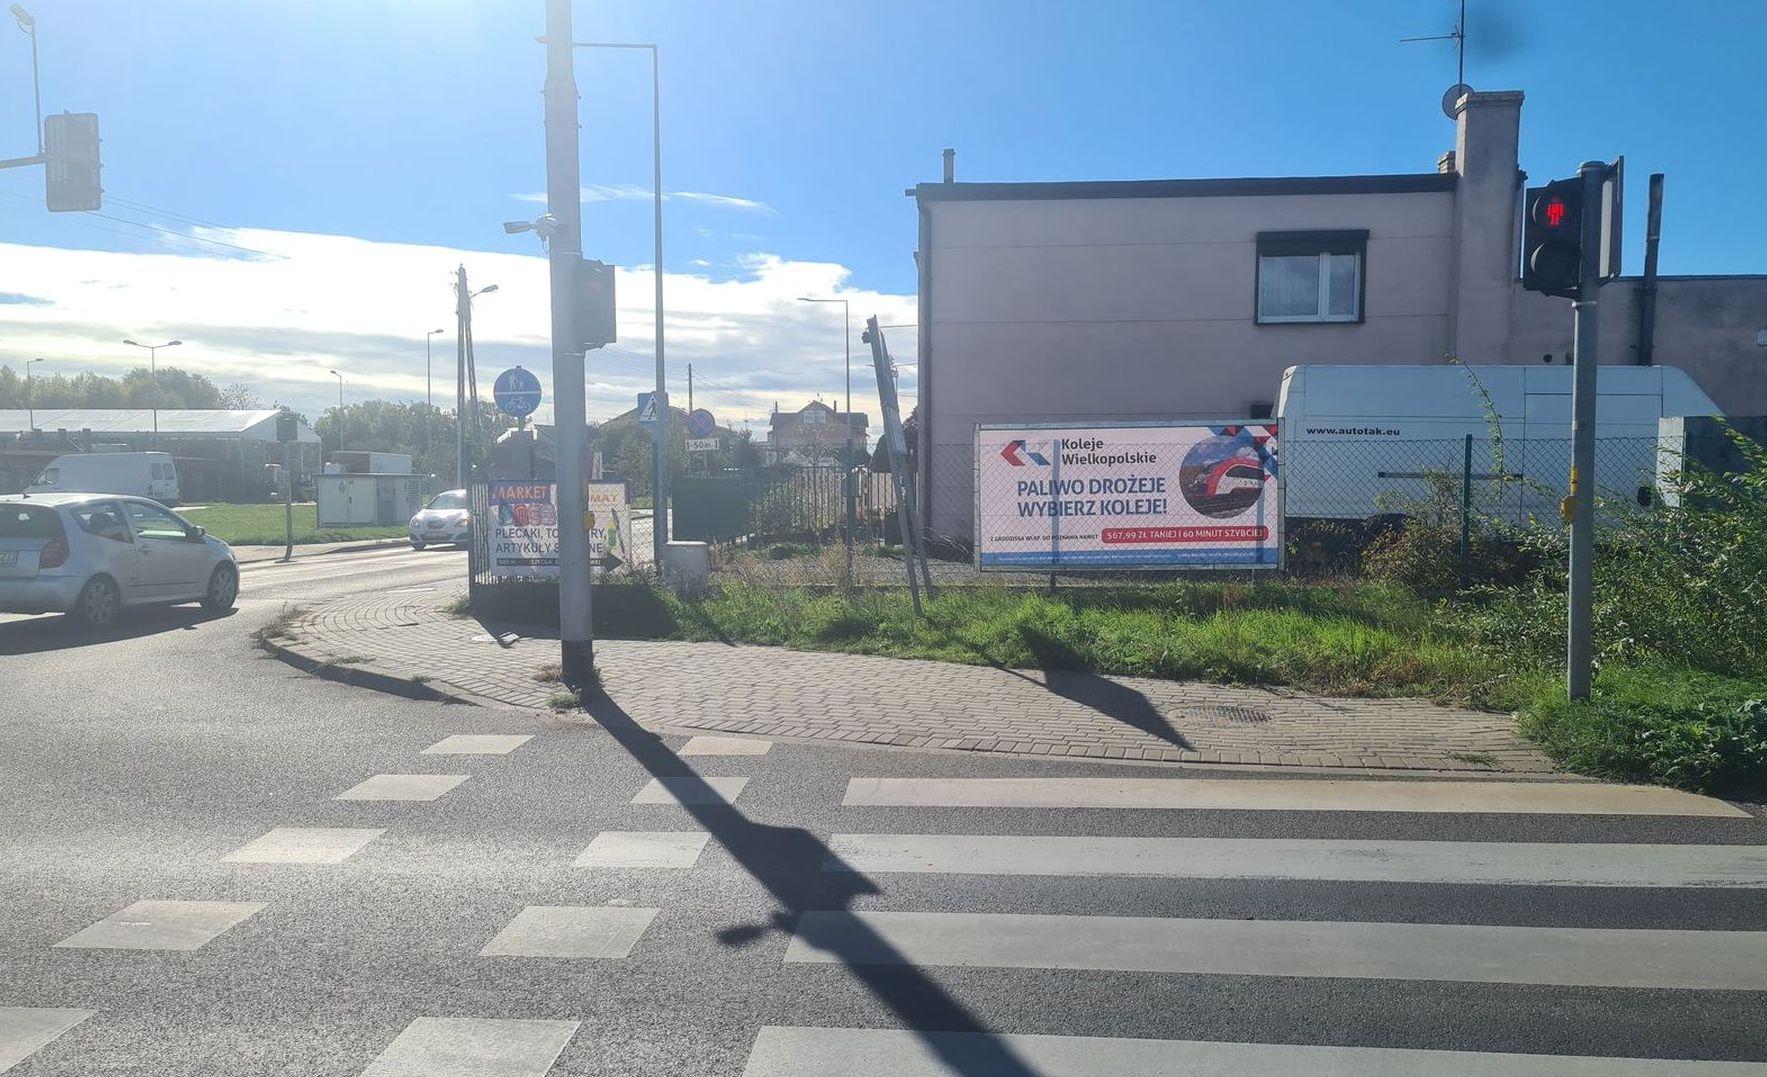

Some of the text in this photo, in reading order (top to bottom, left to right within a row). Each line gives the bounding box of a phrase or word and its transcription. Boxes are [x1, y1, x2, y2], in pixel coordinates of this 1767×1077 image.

[1306, 427, 1400, 436] www.autotak.eu
[1061, 438, 1104, 451] Koleje
[1061, 451, 1157, 467] Wielkopolskie
[1017, 474, 1166, 496] PALIWO DROŻEJE
[491, 485, 547, 500] MARKET
[1017, 498, 1167, 517] WYBIERZ KOLEJE!
[495, 528, 544, 540] PLECAKI,
[1107, 531, 1137, 540] 567,99
[1138, 530, 1147, 539] ZŁ
[1149, 530, 1177, 539] TANIEJ
[1183, 530, 1194, 538] 60
[1195, 529, 1223, 538] MINUT
[1224, 528, 1263, 537] SZYBCIEJ
[495, 542, 552, 553] ARTYKUŁY
